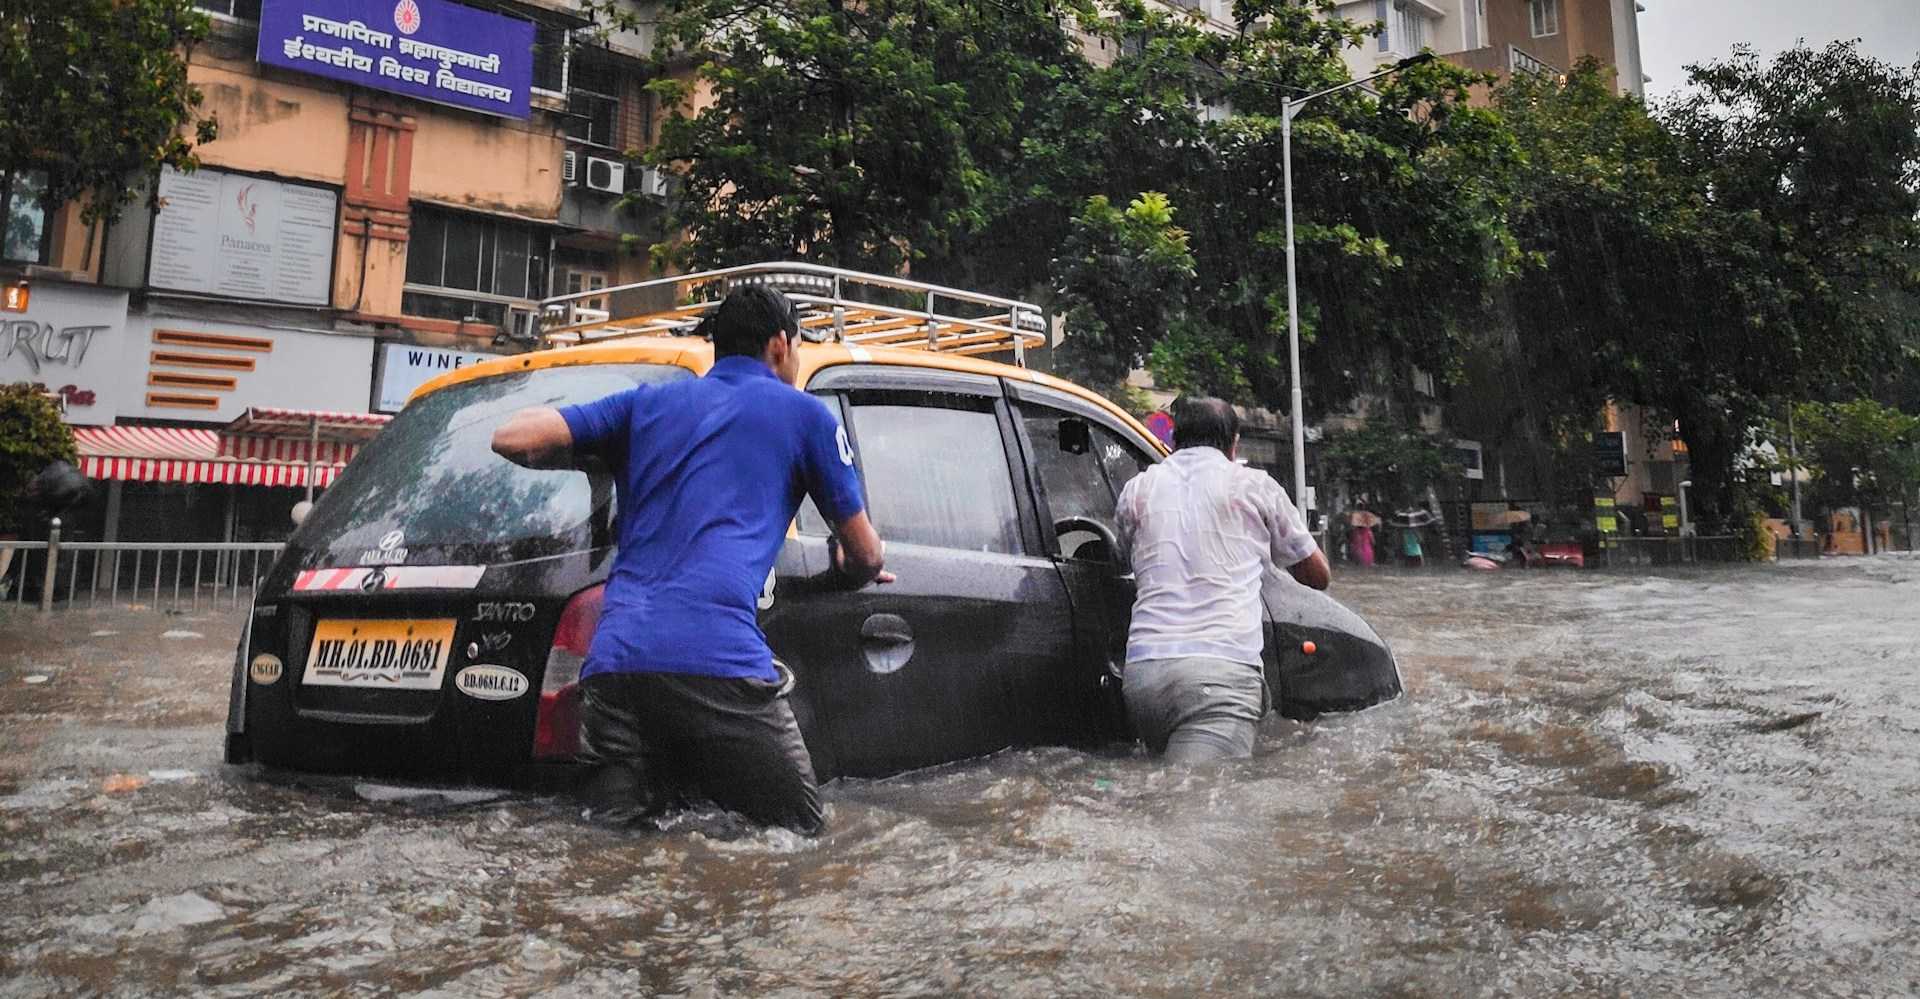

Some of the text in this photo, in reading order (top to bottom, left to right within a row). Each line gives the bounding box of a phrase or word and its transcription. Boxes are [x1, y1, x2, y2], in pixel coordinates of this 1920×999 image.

[302, 14, 500, 74] प्रजापिता ब्रह्माकुमारी
[283, 36, 513, 103] ईश्वरीय विश्व विद्यालय
[221, 234, 272, 253] Panacea
[472, 602, 536, 621] SANTRO
[313, 638, 443, 670] MH.01.BD.0681
